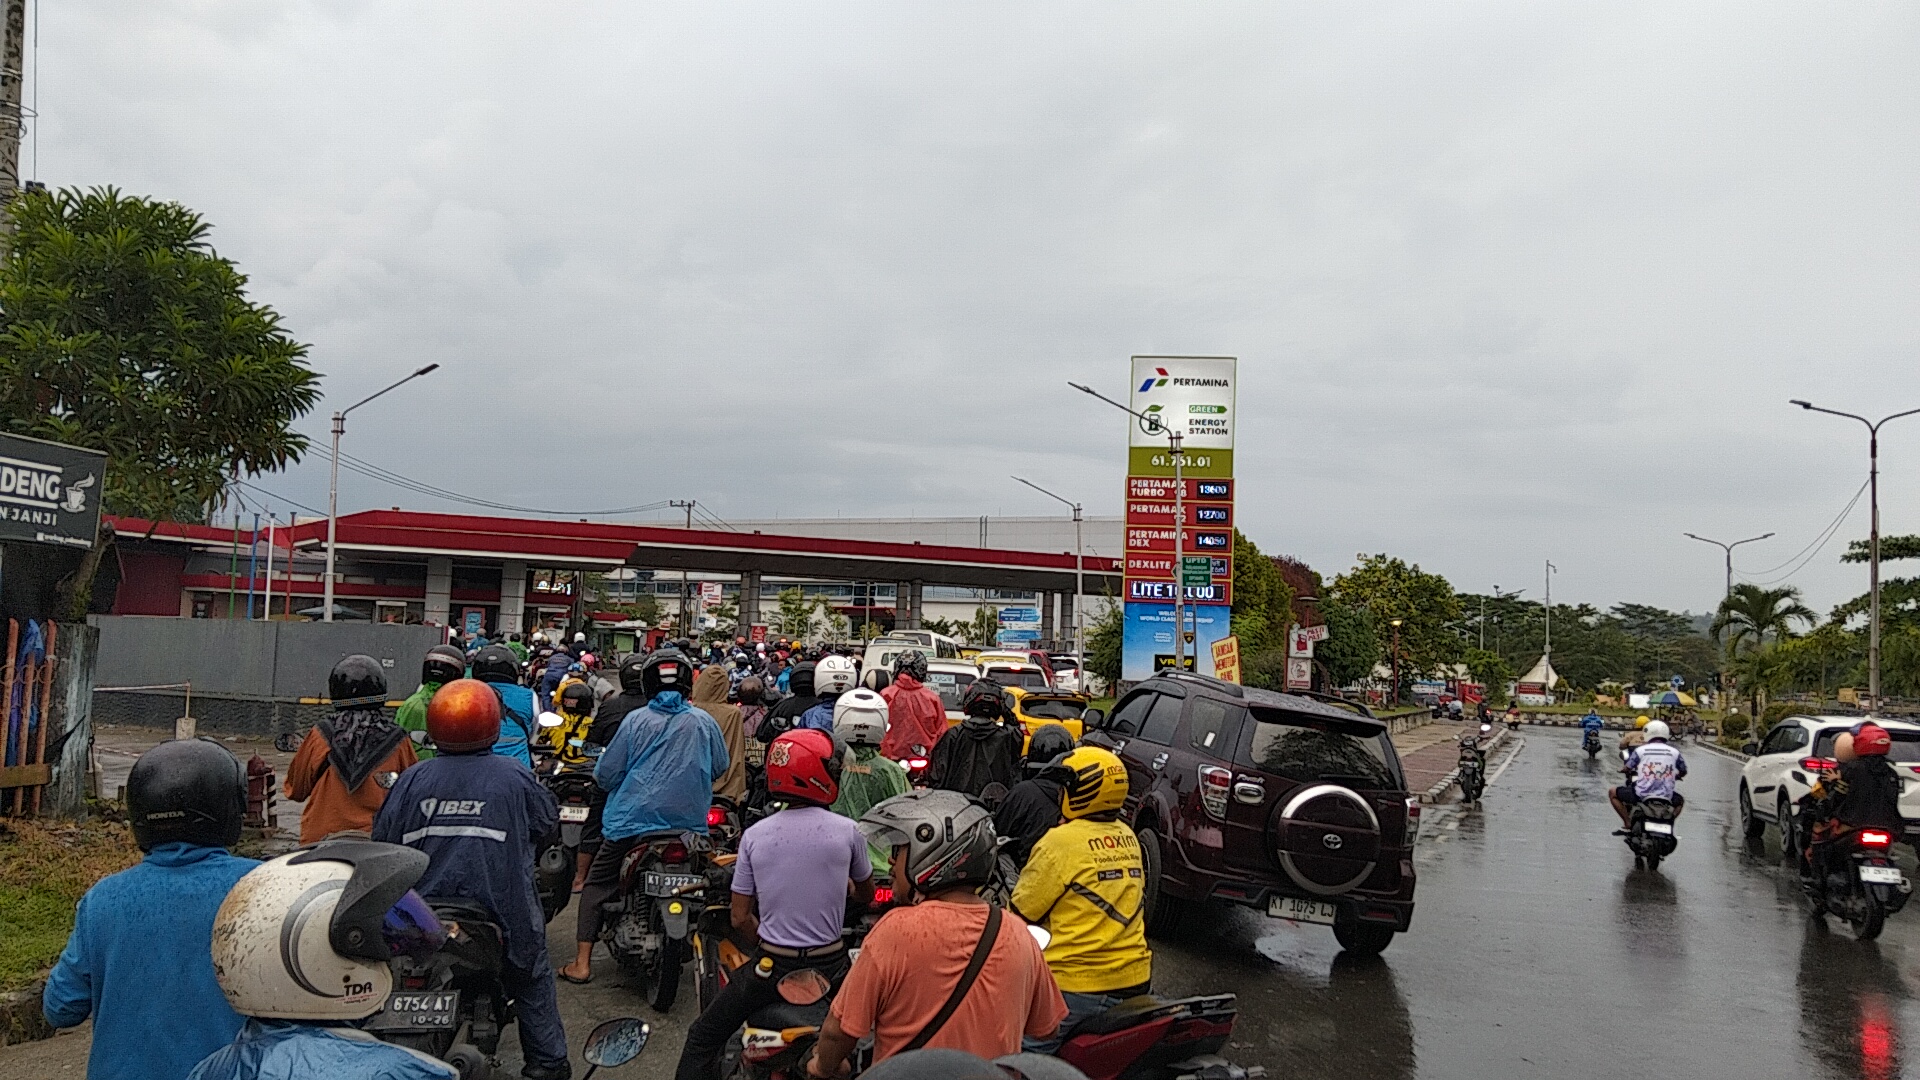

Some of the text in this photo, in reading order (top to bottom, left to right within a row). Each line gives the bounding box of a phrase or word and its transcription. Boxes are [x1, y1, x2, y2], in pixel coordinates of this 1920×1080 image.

[1173, 378, 1229, 388] PERTAMINA
[1189, 419, 1227, 427] ENERGY
[0, 466, 61, 500] DENG
[1130, 479, 1187, 488] PERTAMAX
[1131, 488, 1165, 497] TURBO
[1130, 504, 1187, 514] PERTAMAX
[11, 508, 57, 527] JANJI
[1129, 539, 1150, 547] DEX
[1128, 560, 1171, 570] DEXLITE
[1132, 583, 1163, 597] LITE
[1159, 658, 1193, 666] VR6
[437, 800, 486, 815] IBEX
[1088, 831, 1138, 851] maxim
[648, 875, 660, 886] KT
[664, 877, 689, 887] 3722
[1271, 895, 1284, 910] KT
[433, 995, 453, 1011] AT
